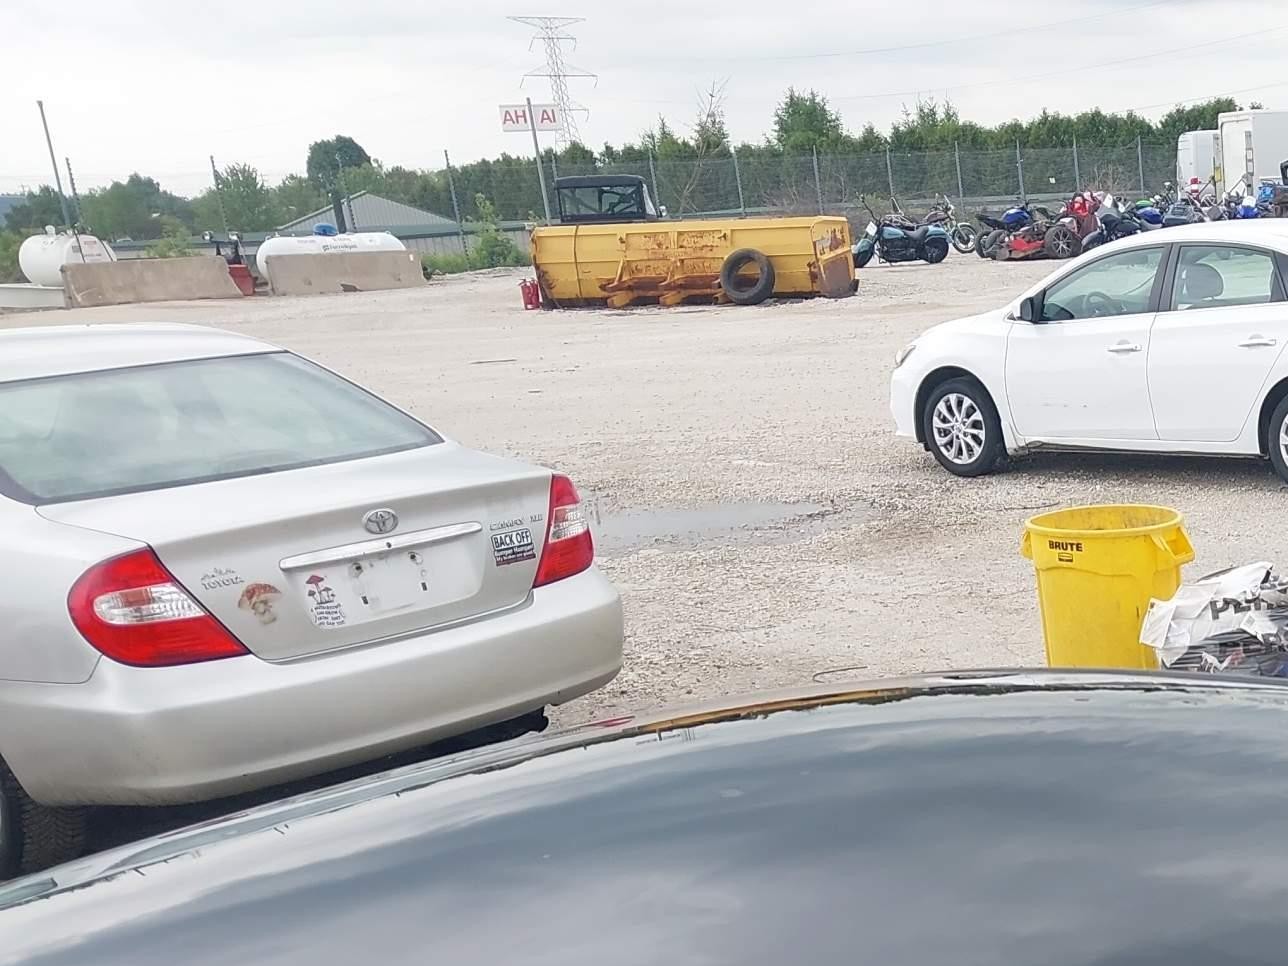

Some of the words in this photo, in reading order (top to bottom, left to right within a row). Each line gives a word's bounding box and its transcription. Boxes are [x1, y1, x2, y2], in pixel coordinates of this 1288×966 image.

[503, 110, 527, 124] AH
[541, 109, 556, 123] AI
[494, 534, 515, 548] BACK
[516, 531, 529, 544] OFF
[1048, 540, 1083, 552] BRUTE
[201, 576, 245, 590] TOYOTA
